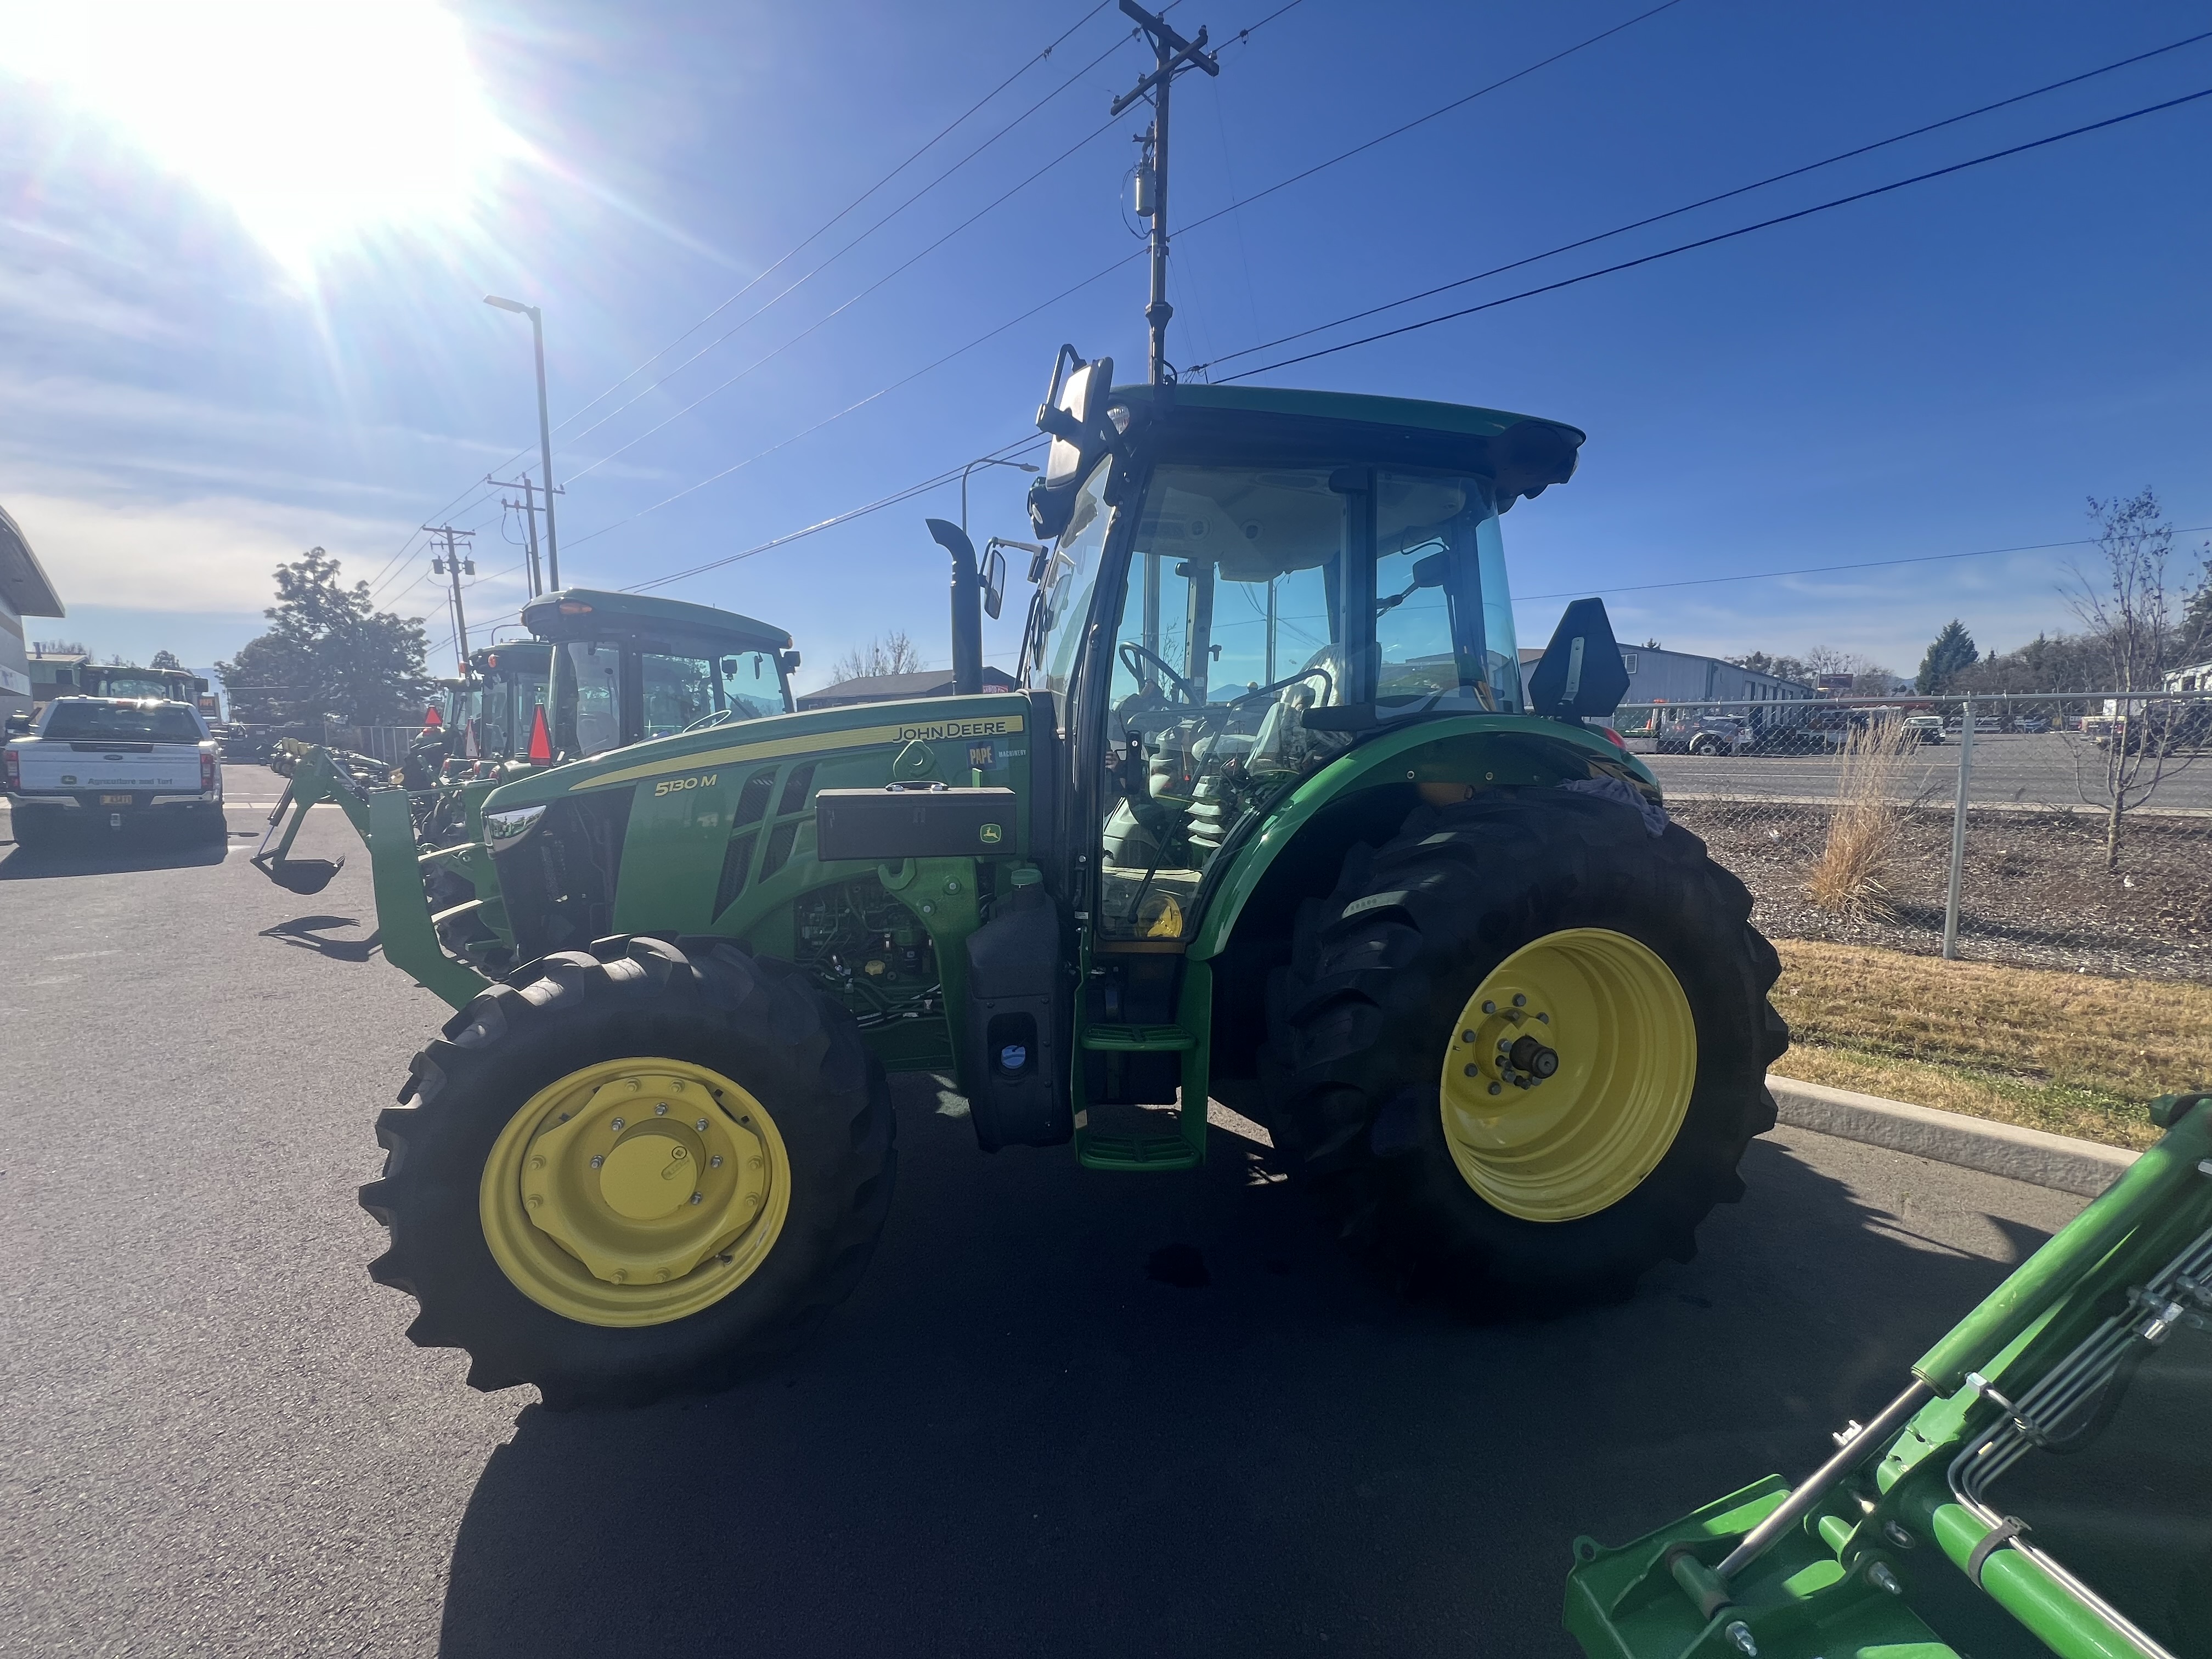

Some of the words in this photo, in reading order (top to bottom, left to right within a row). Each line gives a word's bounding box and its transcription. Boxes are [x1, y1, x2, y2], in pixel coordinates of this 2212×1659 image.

[893, 726, 943, 742] JOHN
[947, 722, 1006, 737] DEERE
[654, 777, 698, 797] 5130
[701, 774, 717, 787] M
